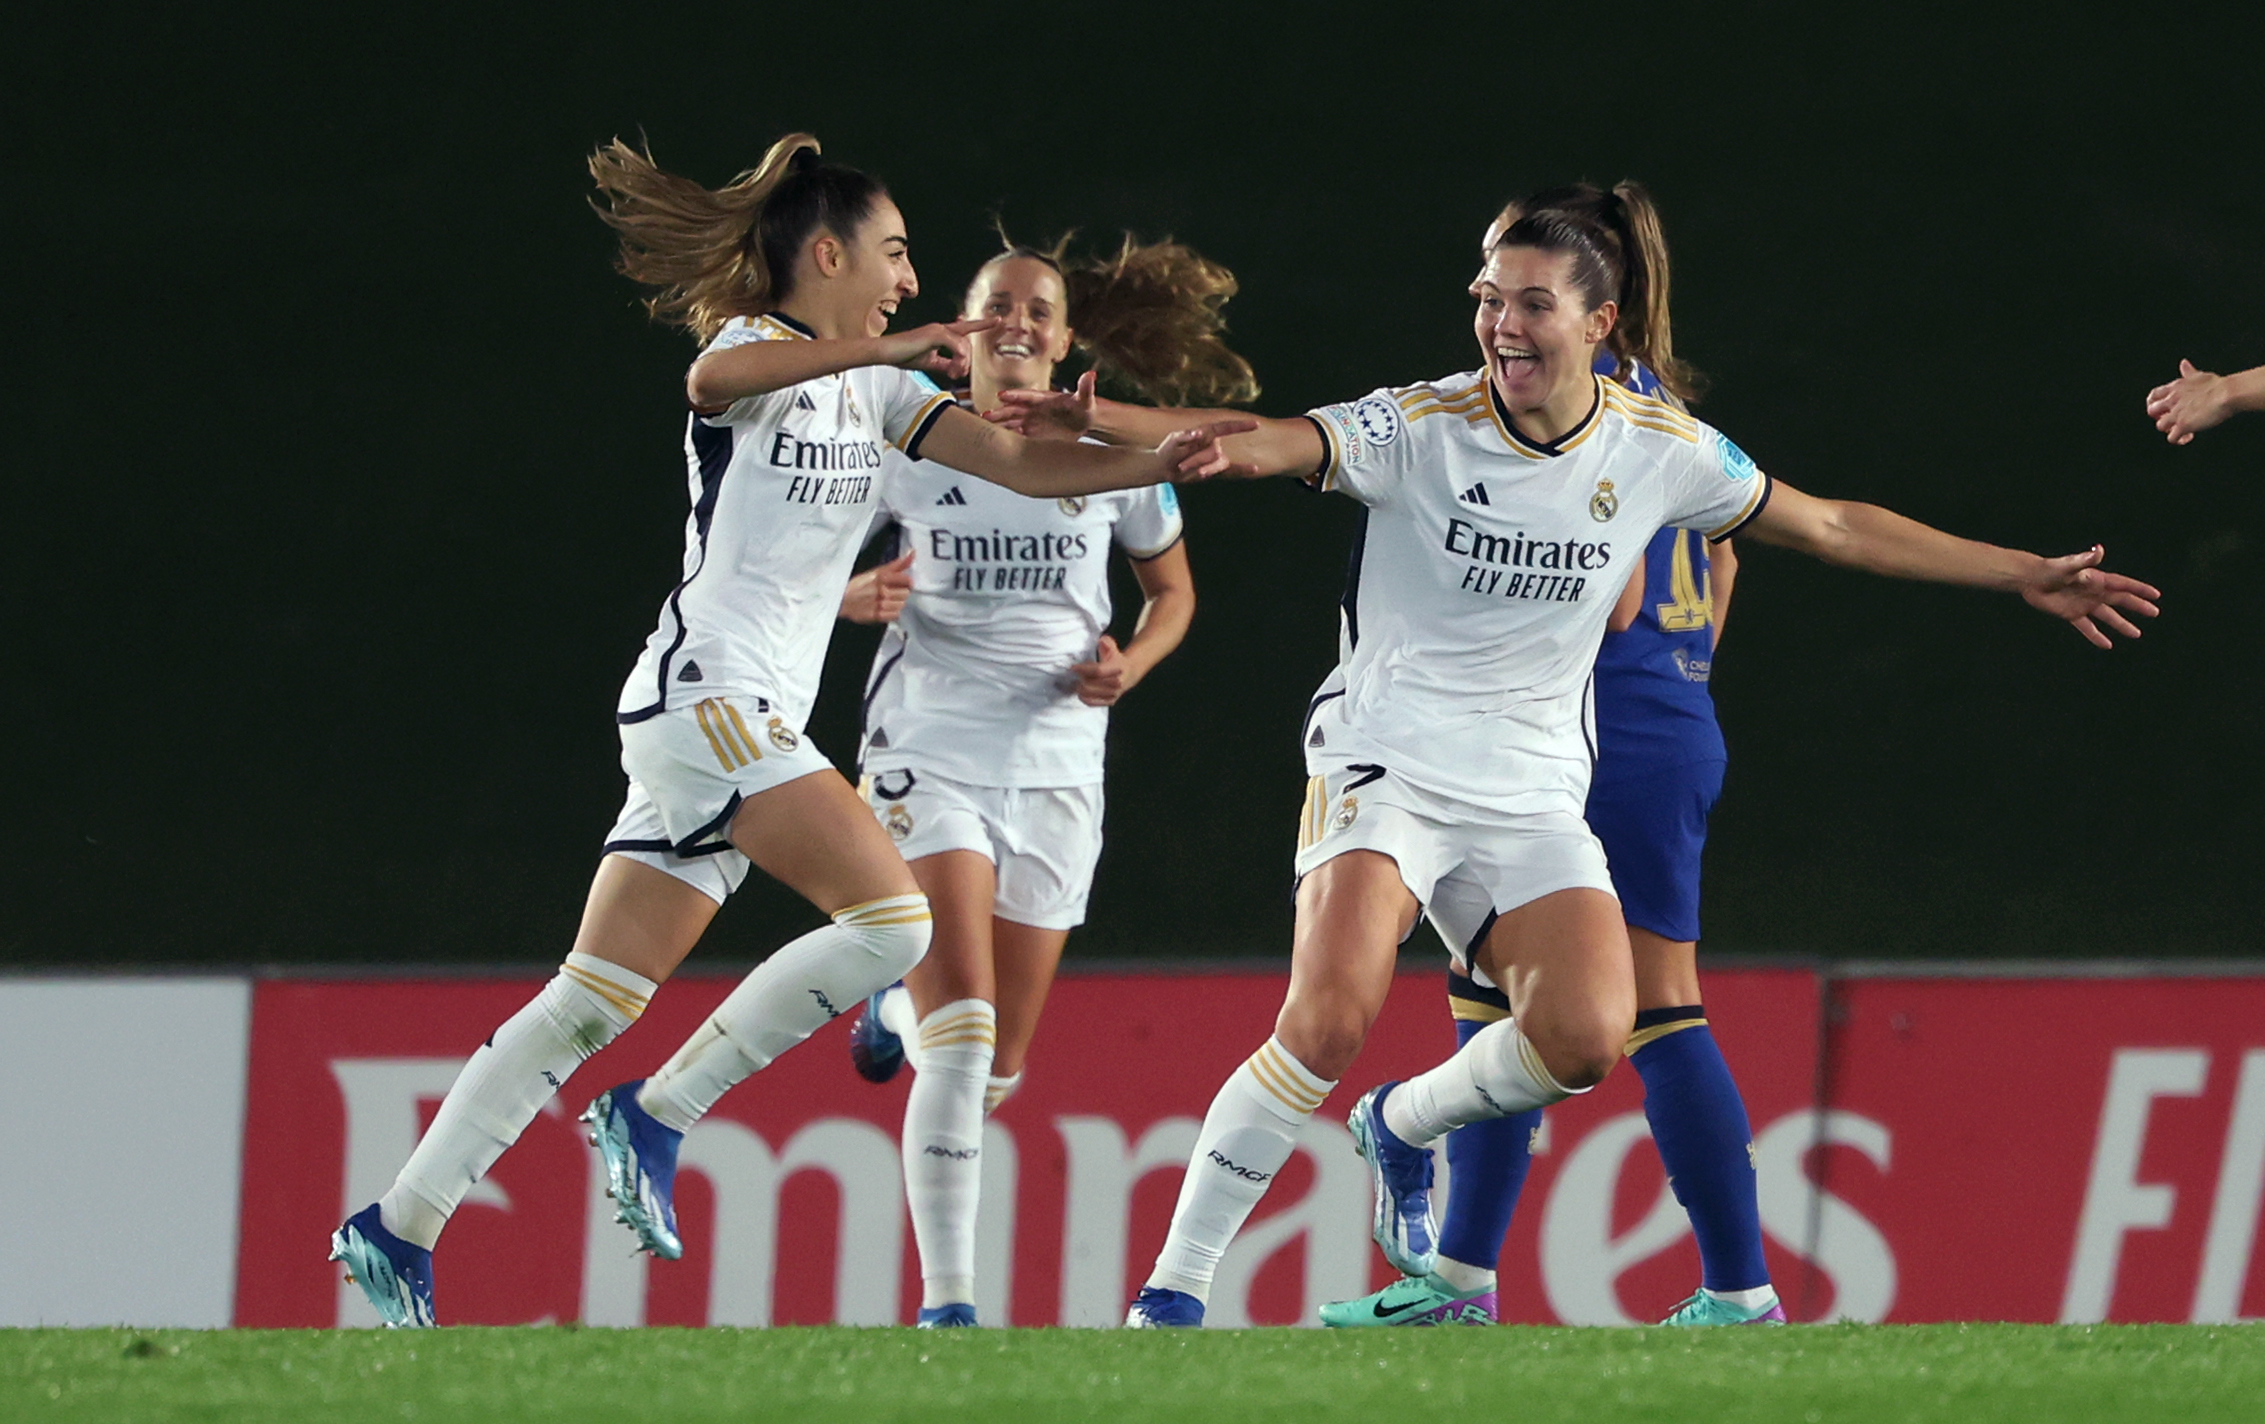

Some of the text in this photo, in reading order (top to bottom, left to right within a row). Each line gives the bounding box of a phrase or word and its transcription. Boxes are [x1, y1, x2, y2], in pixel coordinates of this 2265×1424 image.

[769, 431, 881, 470] Emirates
[786, 476, 872, 504] FLY BETTER
[931, 528, 1088, 562] Emirates
[1445, 517, 1611, 571] Emirates
[954, 567, 1067, 592] FLY BETTER
[1461, 565, 1586, 603] FLY BETTER
[328, 1055, 1898, 1327] Emraes
